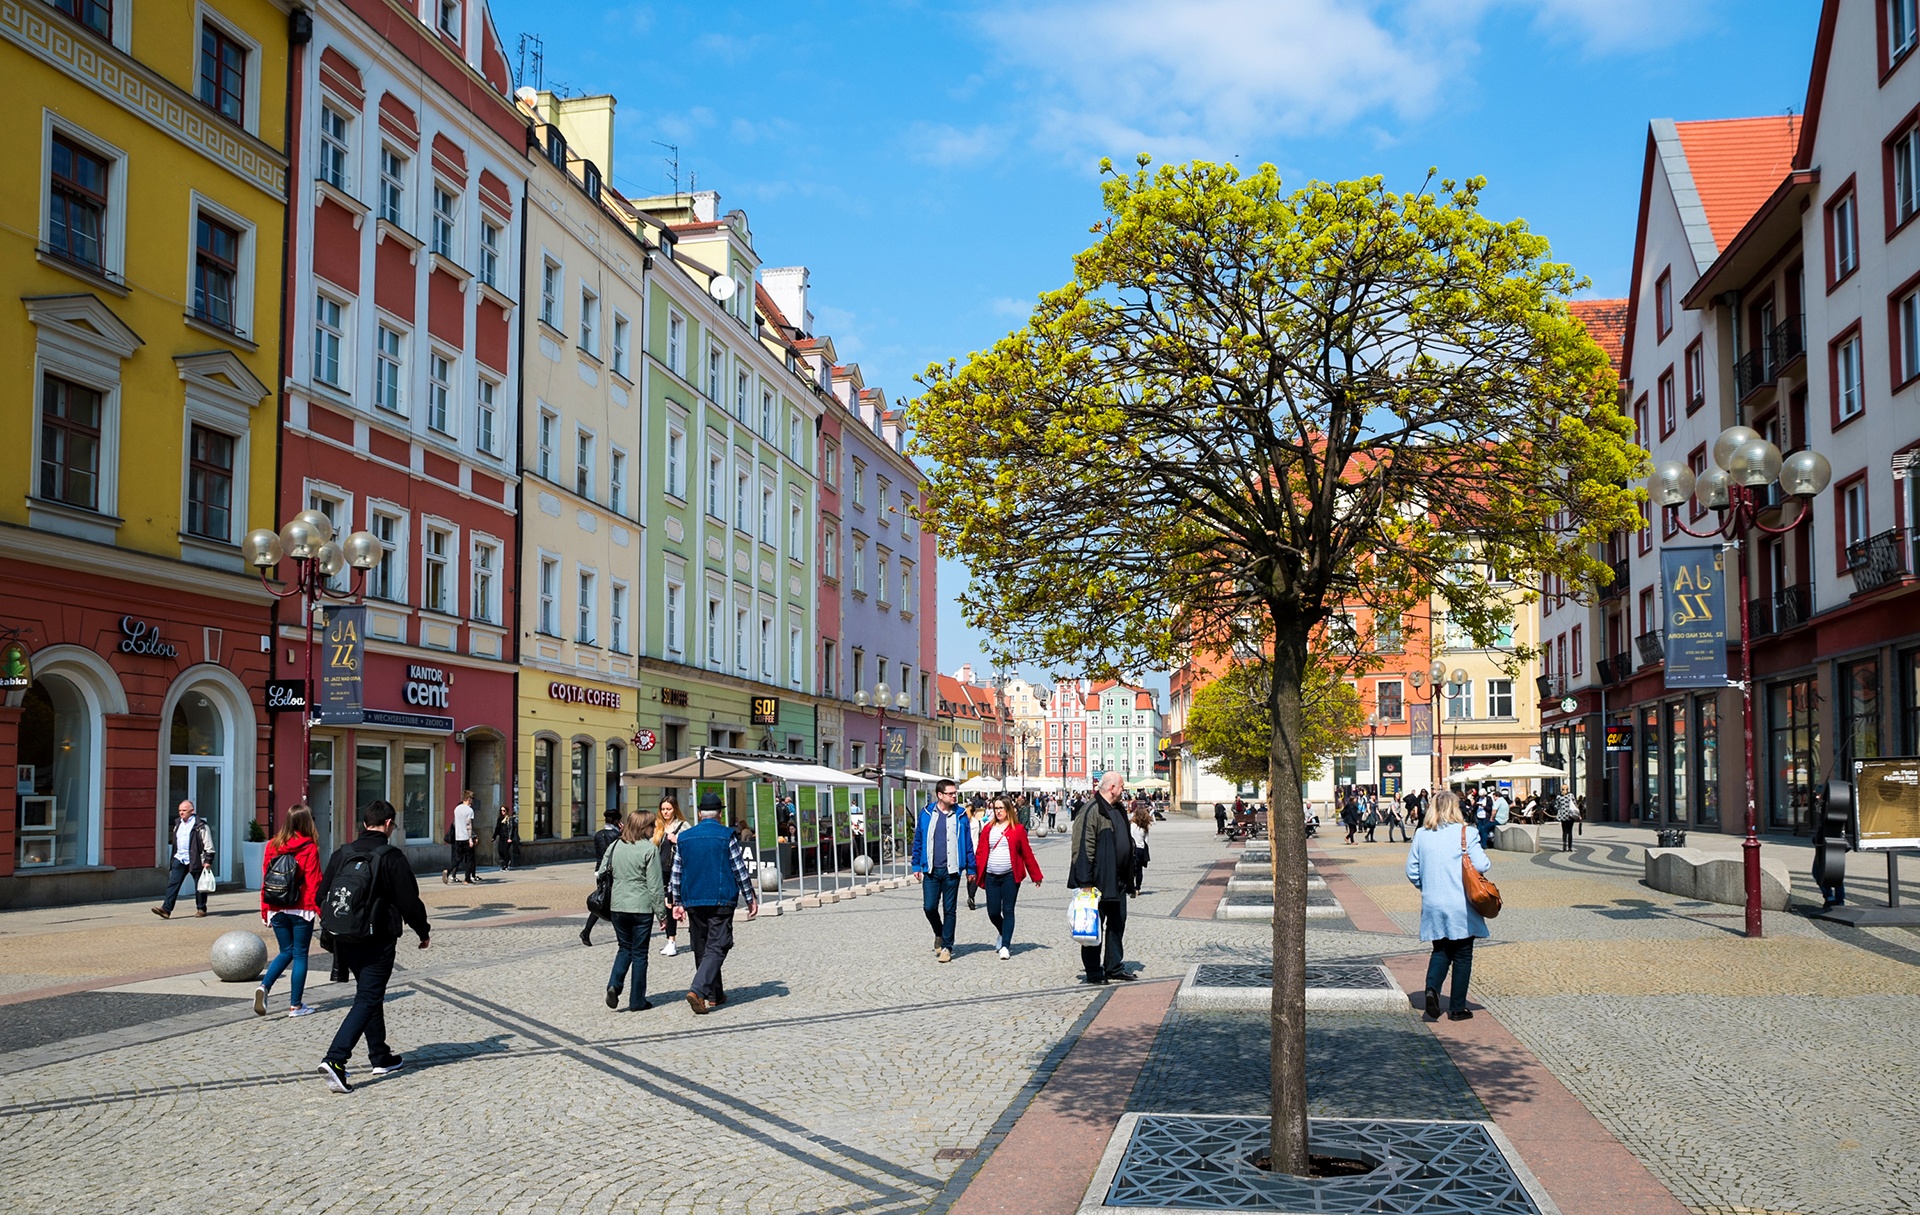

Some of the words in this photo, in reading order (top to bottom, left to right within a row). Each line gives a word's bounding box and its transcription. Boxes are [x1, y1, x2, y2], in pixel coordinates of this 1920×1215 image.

[121, 615, 179, 658] Lilou
[331, 620, 358, 643] JA
[410, 665, 443, 682] KANTOR
[268, 685, 306, 707] Lilou
[407, 681, 449, 708] cent
[551, 683, 584, 702] COSTA
[587, 689, 620, 708] COFFEE
[754, 699, 775, 715] SO!
[373, 713, 419, 725] WECHSELSTUBE
[425, 718, 444, 727] ZŁOTO
[754, 715, 775, 723] COFFEE
[1481, 743, 1507, 751] EXPRESS
